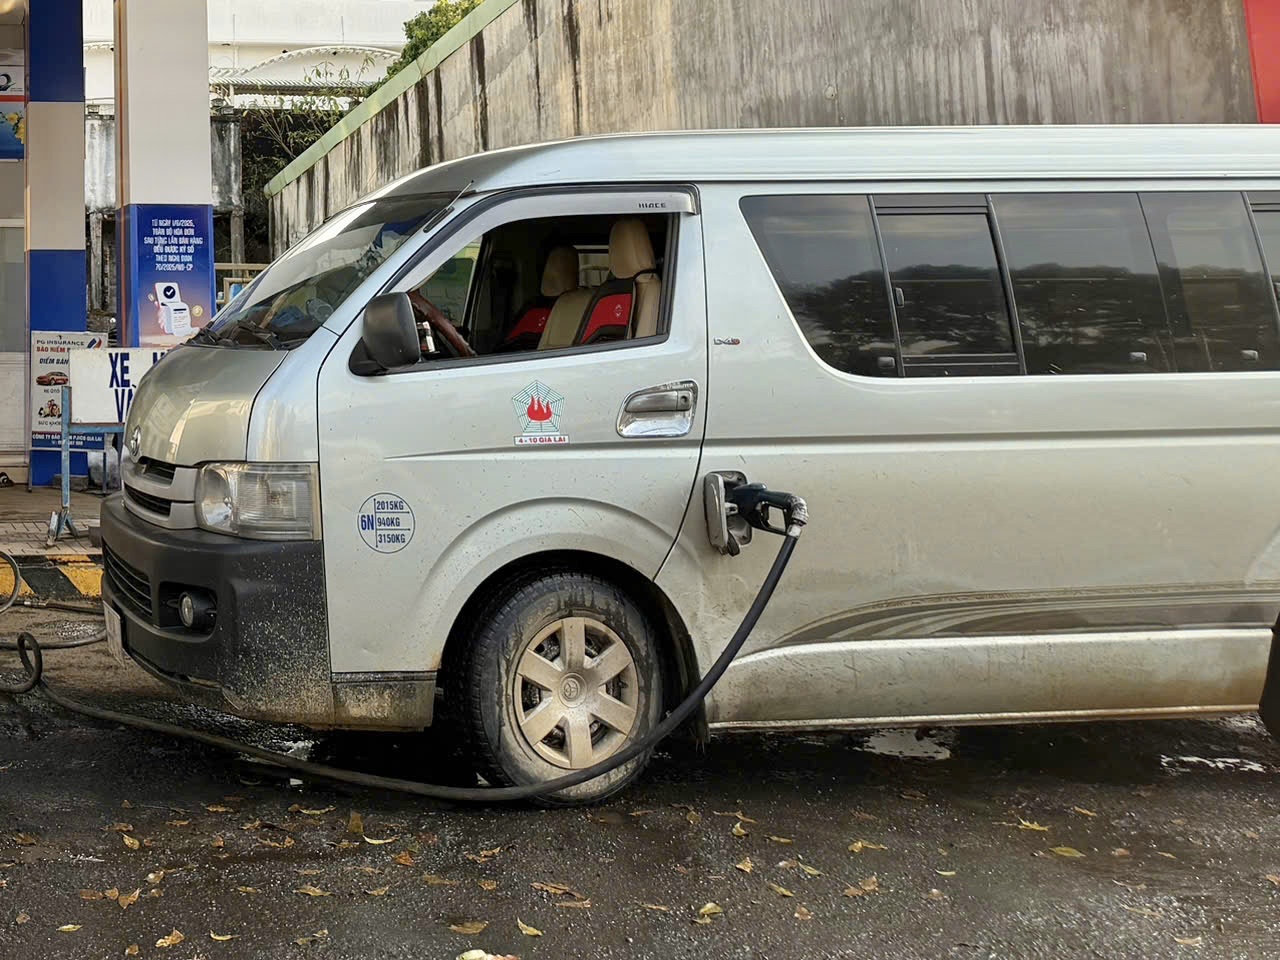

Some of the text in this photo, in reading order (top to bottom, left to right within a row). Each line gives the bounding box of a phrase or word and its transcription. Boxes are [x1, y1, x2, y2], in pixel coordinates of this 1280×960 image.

[108, 352, 131, 388] XE
[376, 500, 404, 510] 2015KG
[360, 514, 375, 530] 6N
[377, 517, 401, 527] 940KG
[377, 533, 406, 544] 3150KG
